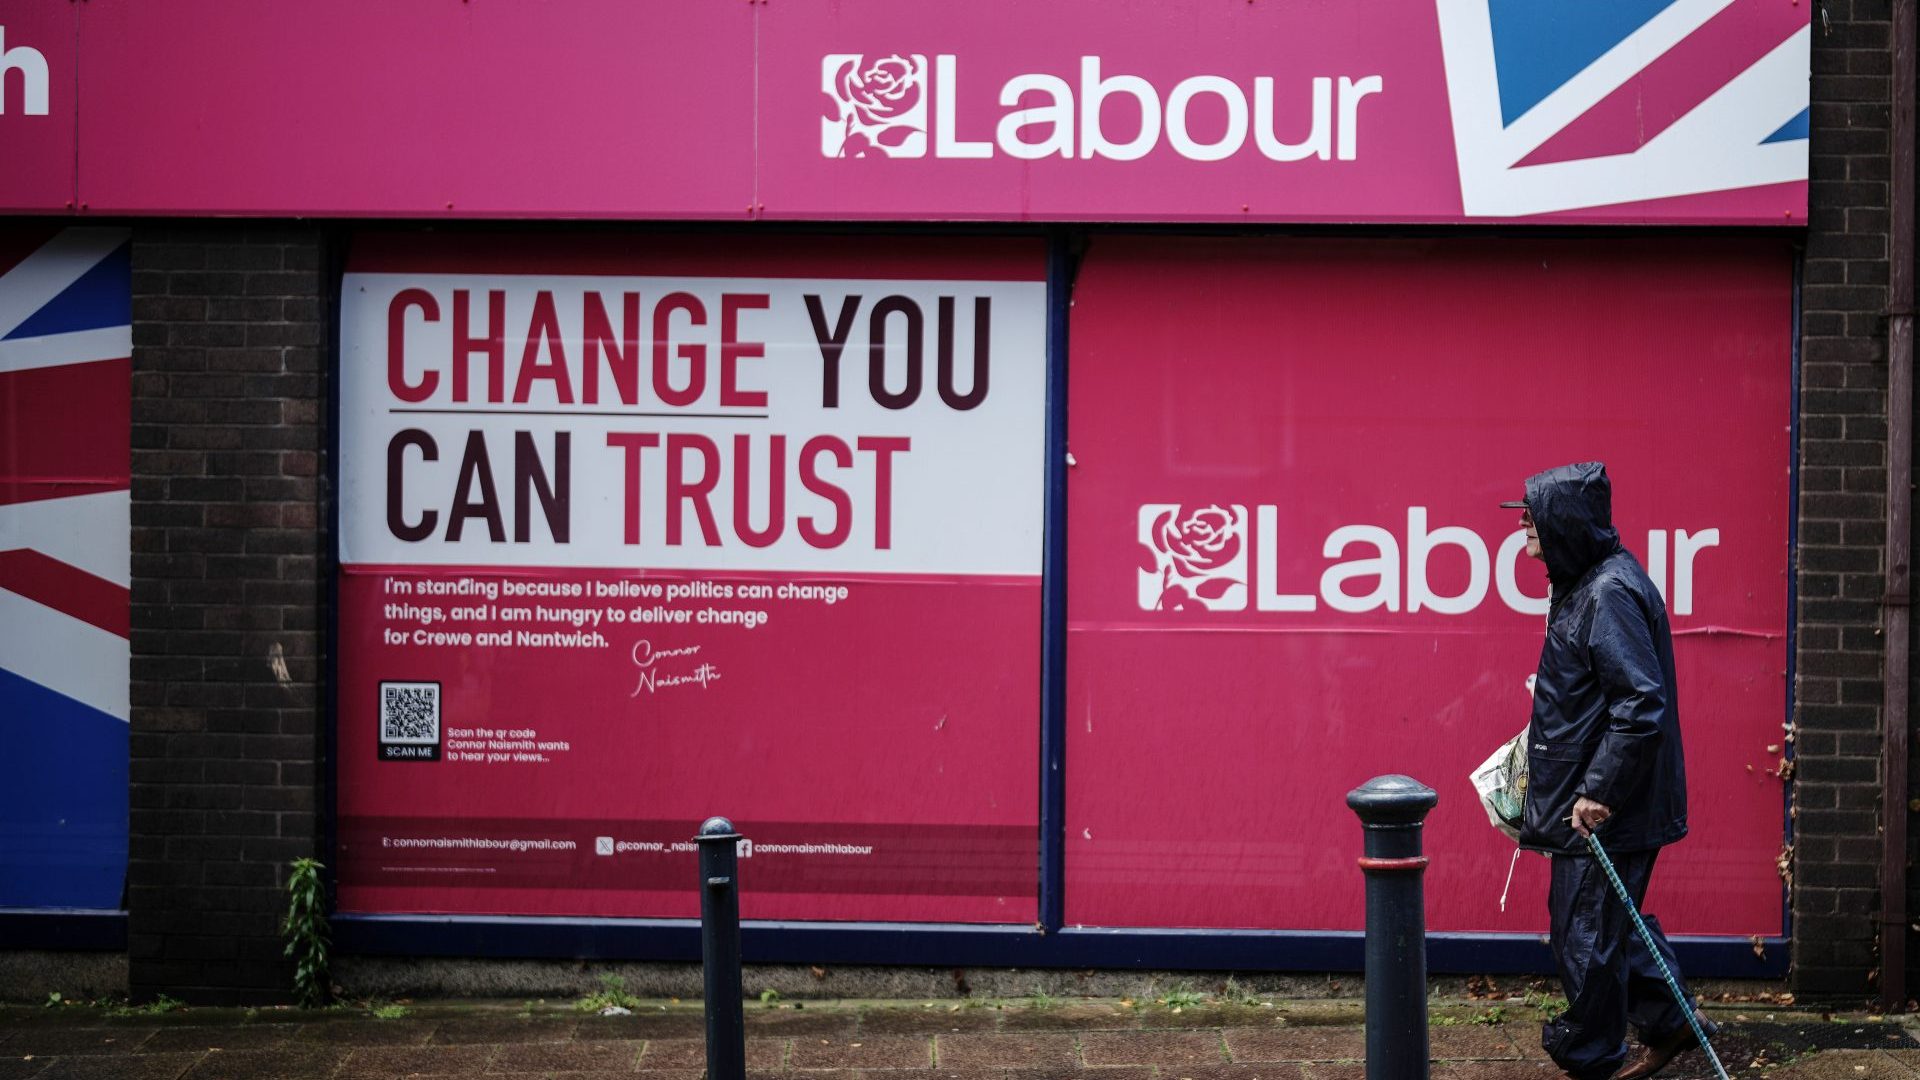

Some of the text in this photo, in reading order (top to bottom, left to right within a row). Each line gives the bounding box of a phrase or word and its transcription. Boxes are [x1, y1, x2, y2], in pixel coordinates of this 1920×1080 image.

[936, 55, 1382, 161] Labour
[388, 288, 992, 411] CHANGE YOU
[387, 427, 911, 550] CAN TRUST
[384, 577, 849, 605] I'm standing because I believe politics can change
[384, 603, 769, 628] things, and I am hungry to deliver change
[384, 629, 609, 648] for Crewe and Nantwich.
[632, 639, 702, 668] Connor
[631, 662, 722, 697] Naismith
[447, 728, 536, 741] Scan the qr code
[447, 739, 570, 751] Connor Naismith wants
[386, 746, 433, 758] SCAN ME
[447, 751, 458, 761] to
[460, 751, 485, 761] hear
[487, 754, 511, 764] your
[393, 838, 577, 852] connornaismithlabour@gmail.com
[754, 843, 873, 855] connornaismithlabour
